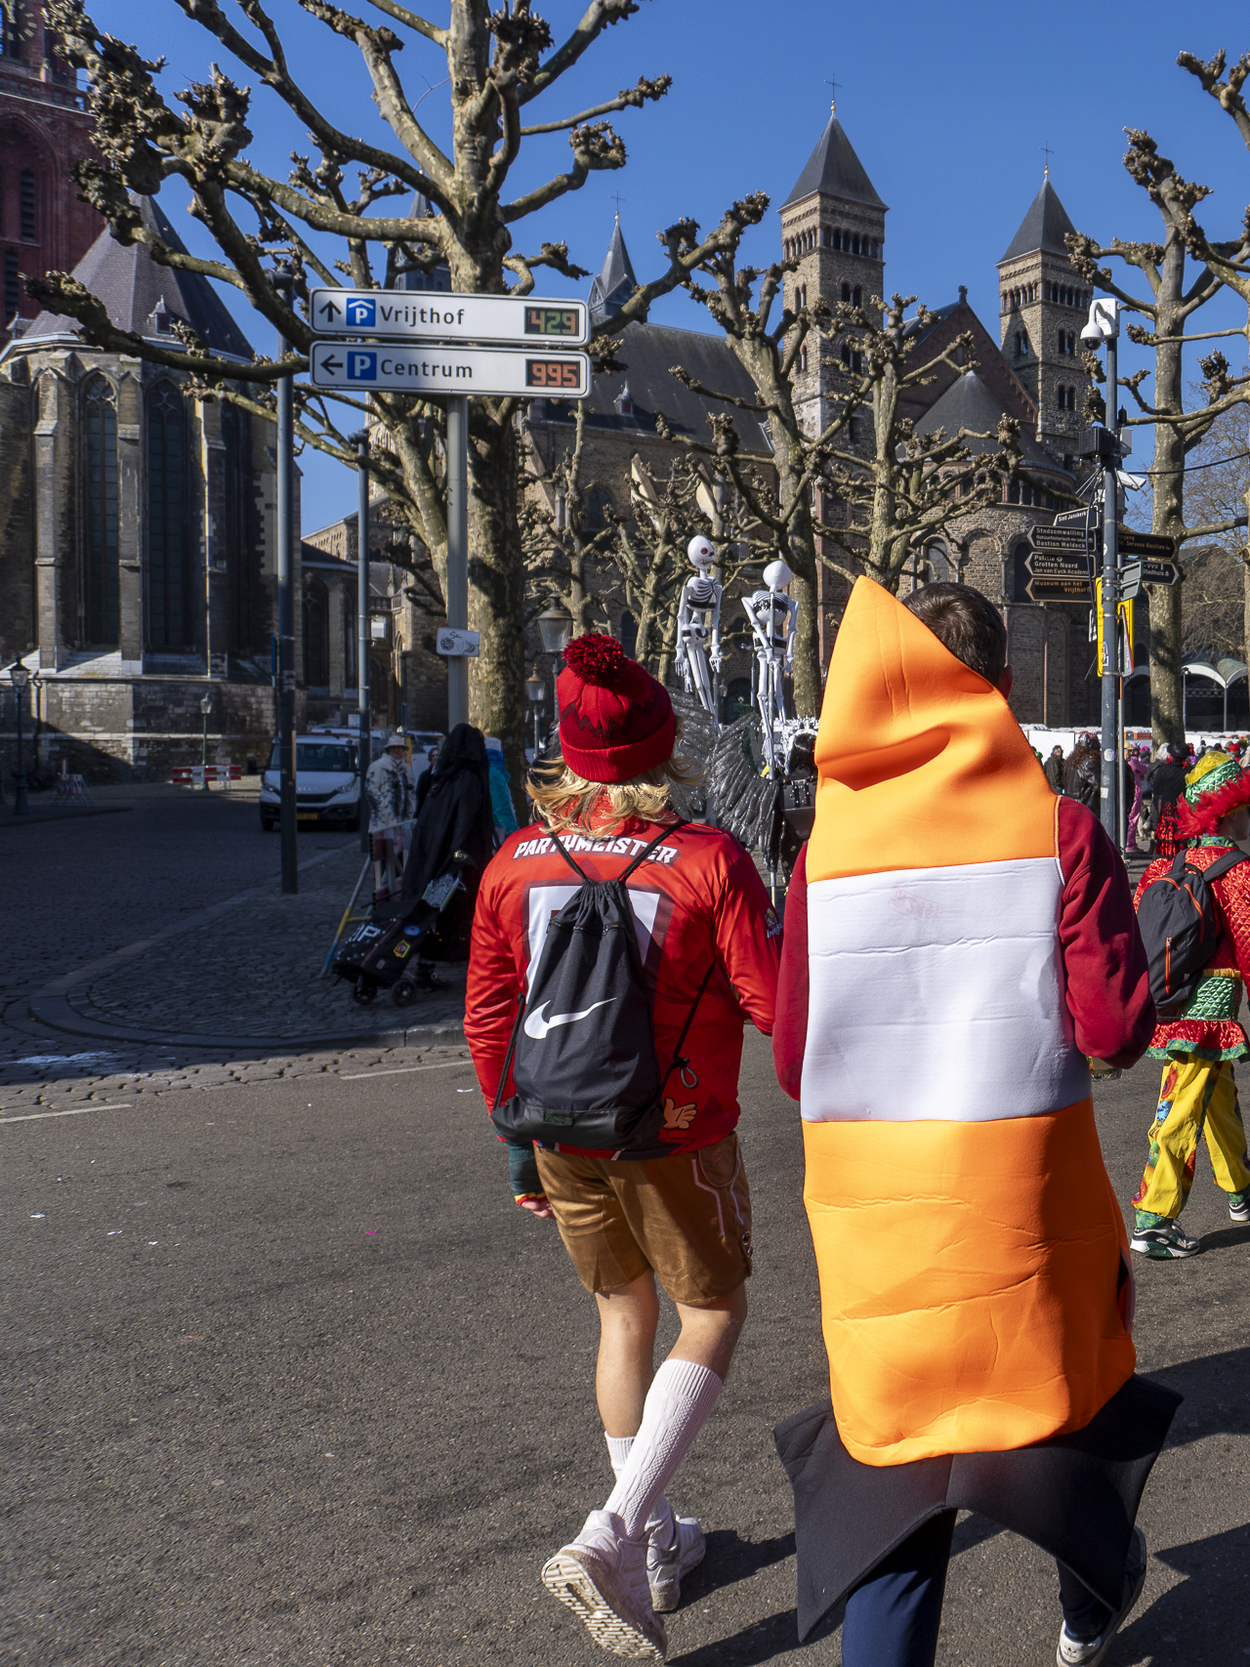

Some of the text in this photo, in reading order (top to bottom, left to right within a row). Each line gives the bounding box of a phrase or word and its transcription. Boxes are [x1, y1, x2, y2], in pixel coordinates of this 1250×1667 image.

[380, 305, 465, 327] Vrijthof
[530, 310, 577, 334] 429
[380, 359, 473, 379] Centrum
[531, 362, 578, 388] 995
[1036, 528, 1084, 538] Stadsomwalling
[512, 834, 679, 864] PARTYMEISTER
